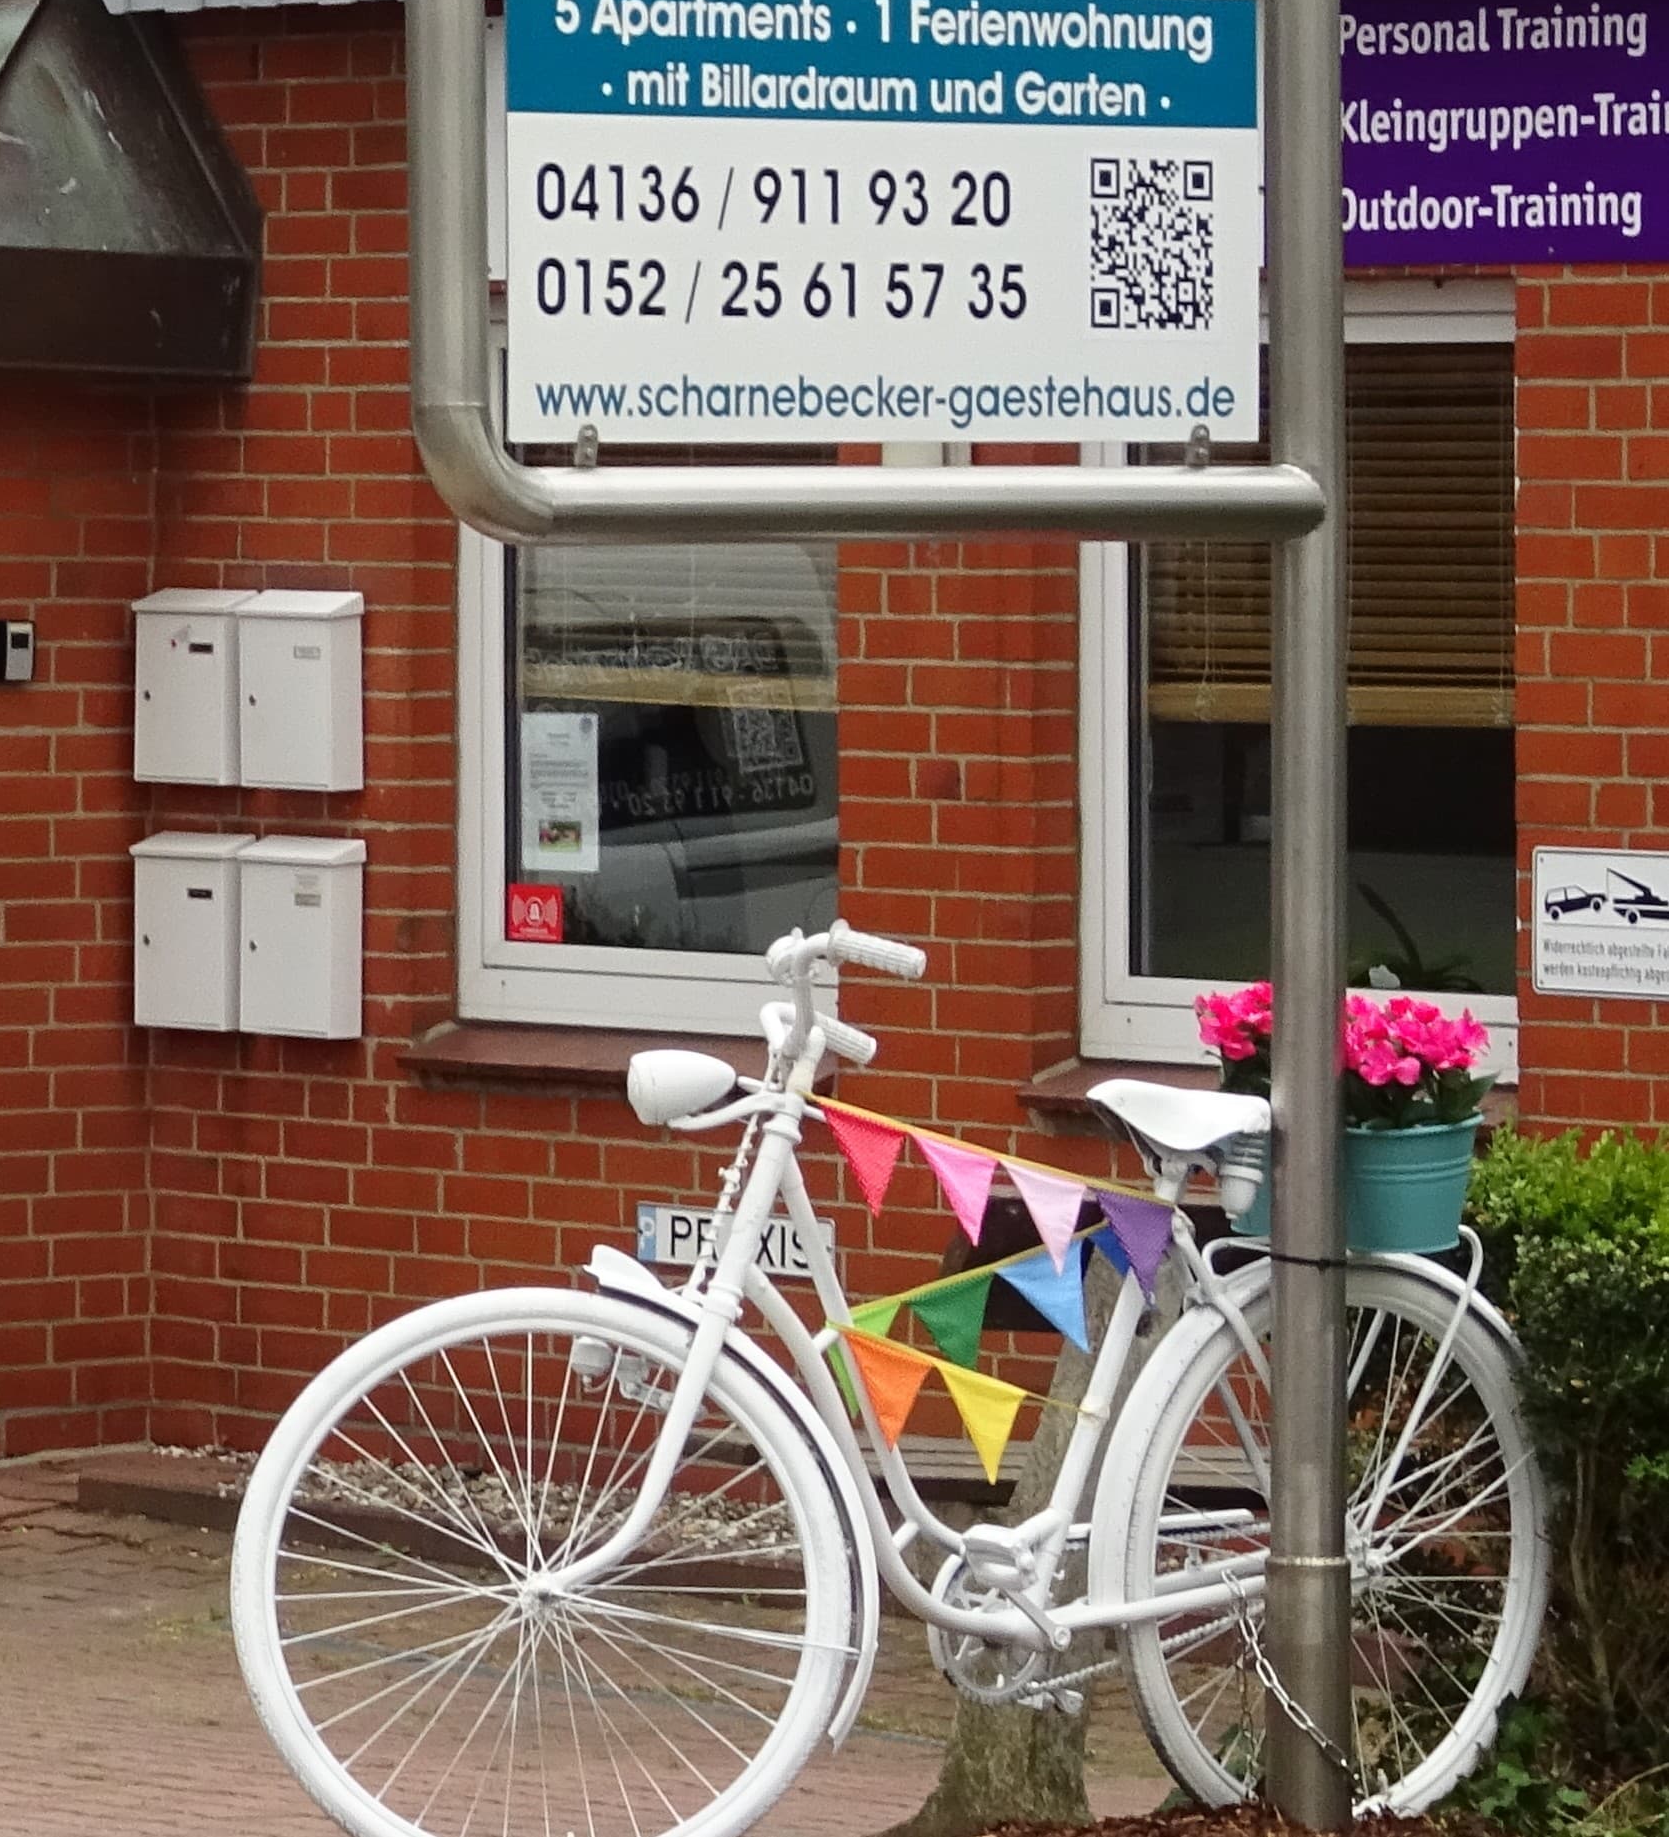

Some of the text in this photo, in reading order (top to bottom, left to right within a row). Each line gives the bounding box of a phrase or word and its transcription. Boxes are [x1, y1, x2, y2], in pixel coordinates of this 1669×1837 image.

[1340, 2, 1647, 58] Personal Training
[627, 62, 690, 107] mit
[701, 62, 918, 112] Billardraum
[930, 70, 1003, 115] und
[1014, 70, 1146, 117] Garten
[1341, 89, 1669, 153] Kleingruppen-Trai
[537, 162, 700, 223] 04136
[753, 167, 839, 225] 911
[868, 169, 929, 227] 93
[951, 170, 1011, 228] 20
[537, 257, 666, 317] 0152
[721, 260, 782, 318] 25
[803, 262, 856, 319] 61
[885, 263, 945, 319] 57
[968, 263, 1027, 320] 35
[535, 374, 1235, 428] www.scharnebecker-gaestehaus.de
